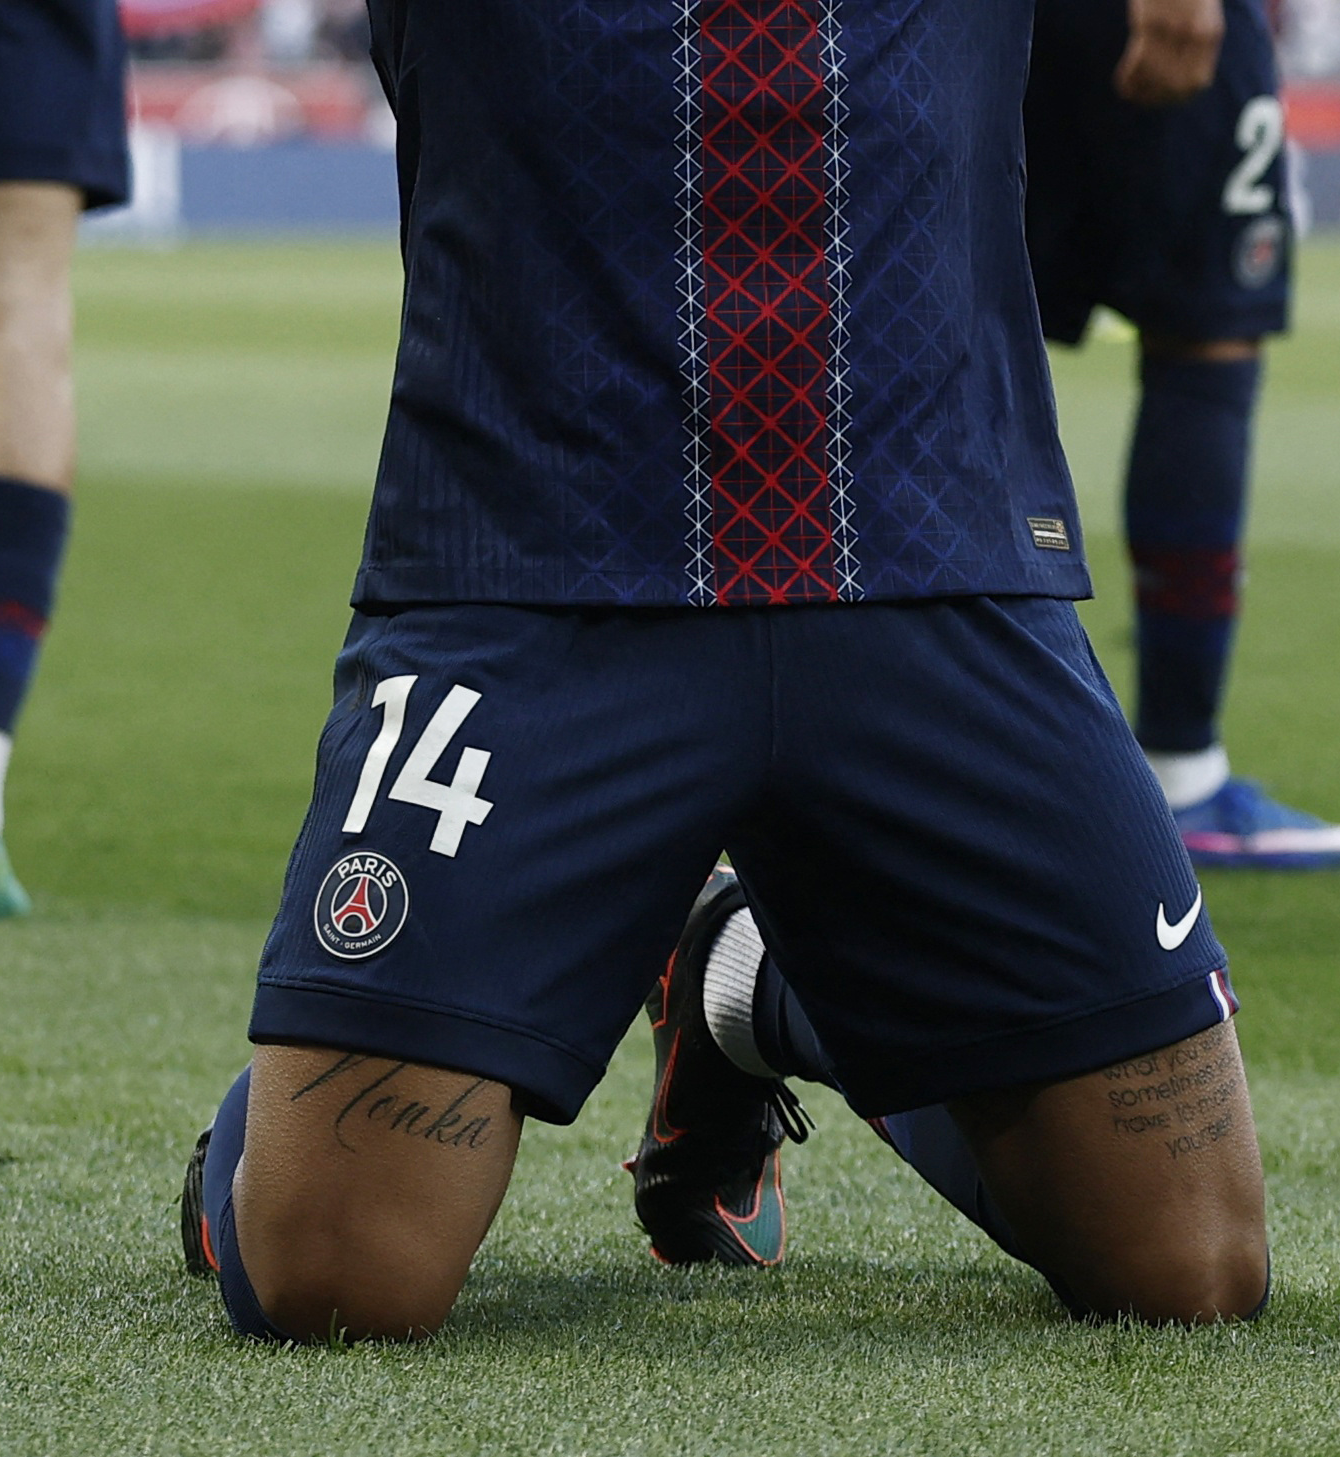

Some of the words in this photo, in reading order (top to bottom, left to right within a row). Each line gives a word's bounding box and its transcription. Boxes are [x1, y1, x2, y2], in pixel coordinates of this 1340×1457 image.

[342, 674, 495, 858] 14
[337, 857, 398, 888] PARIS
[323, 923, 341, 944] SAINT
[344, 933, 382, 949] GERMAIN
